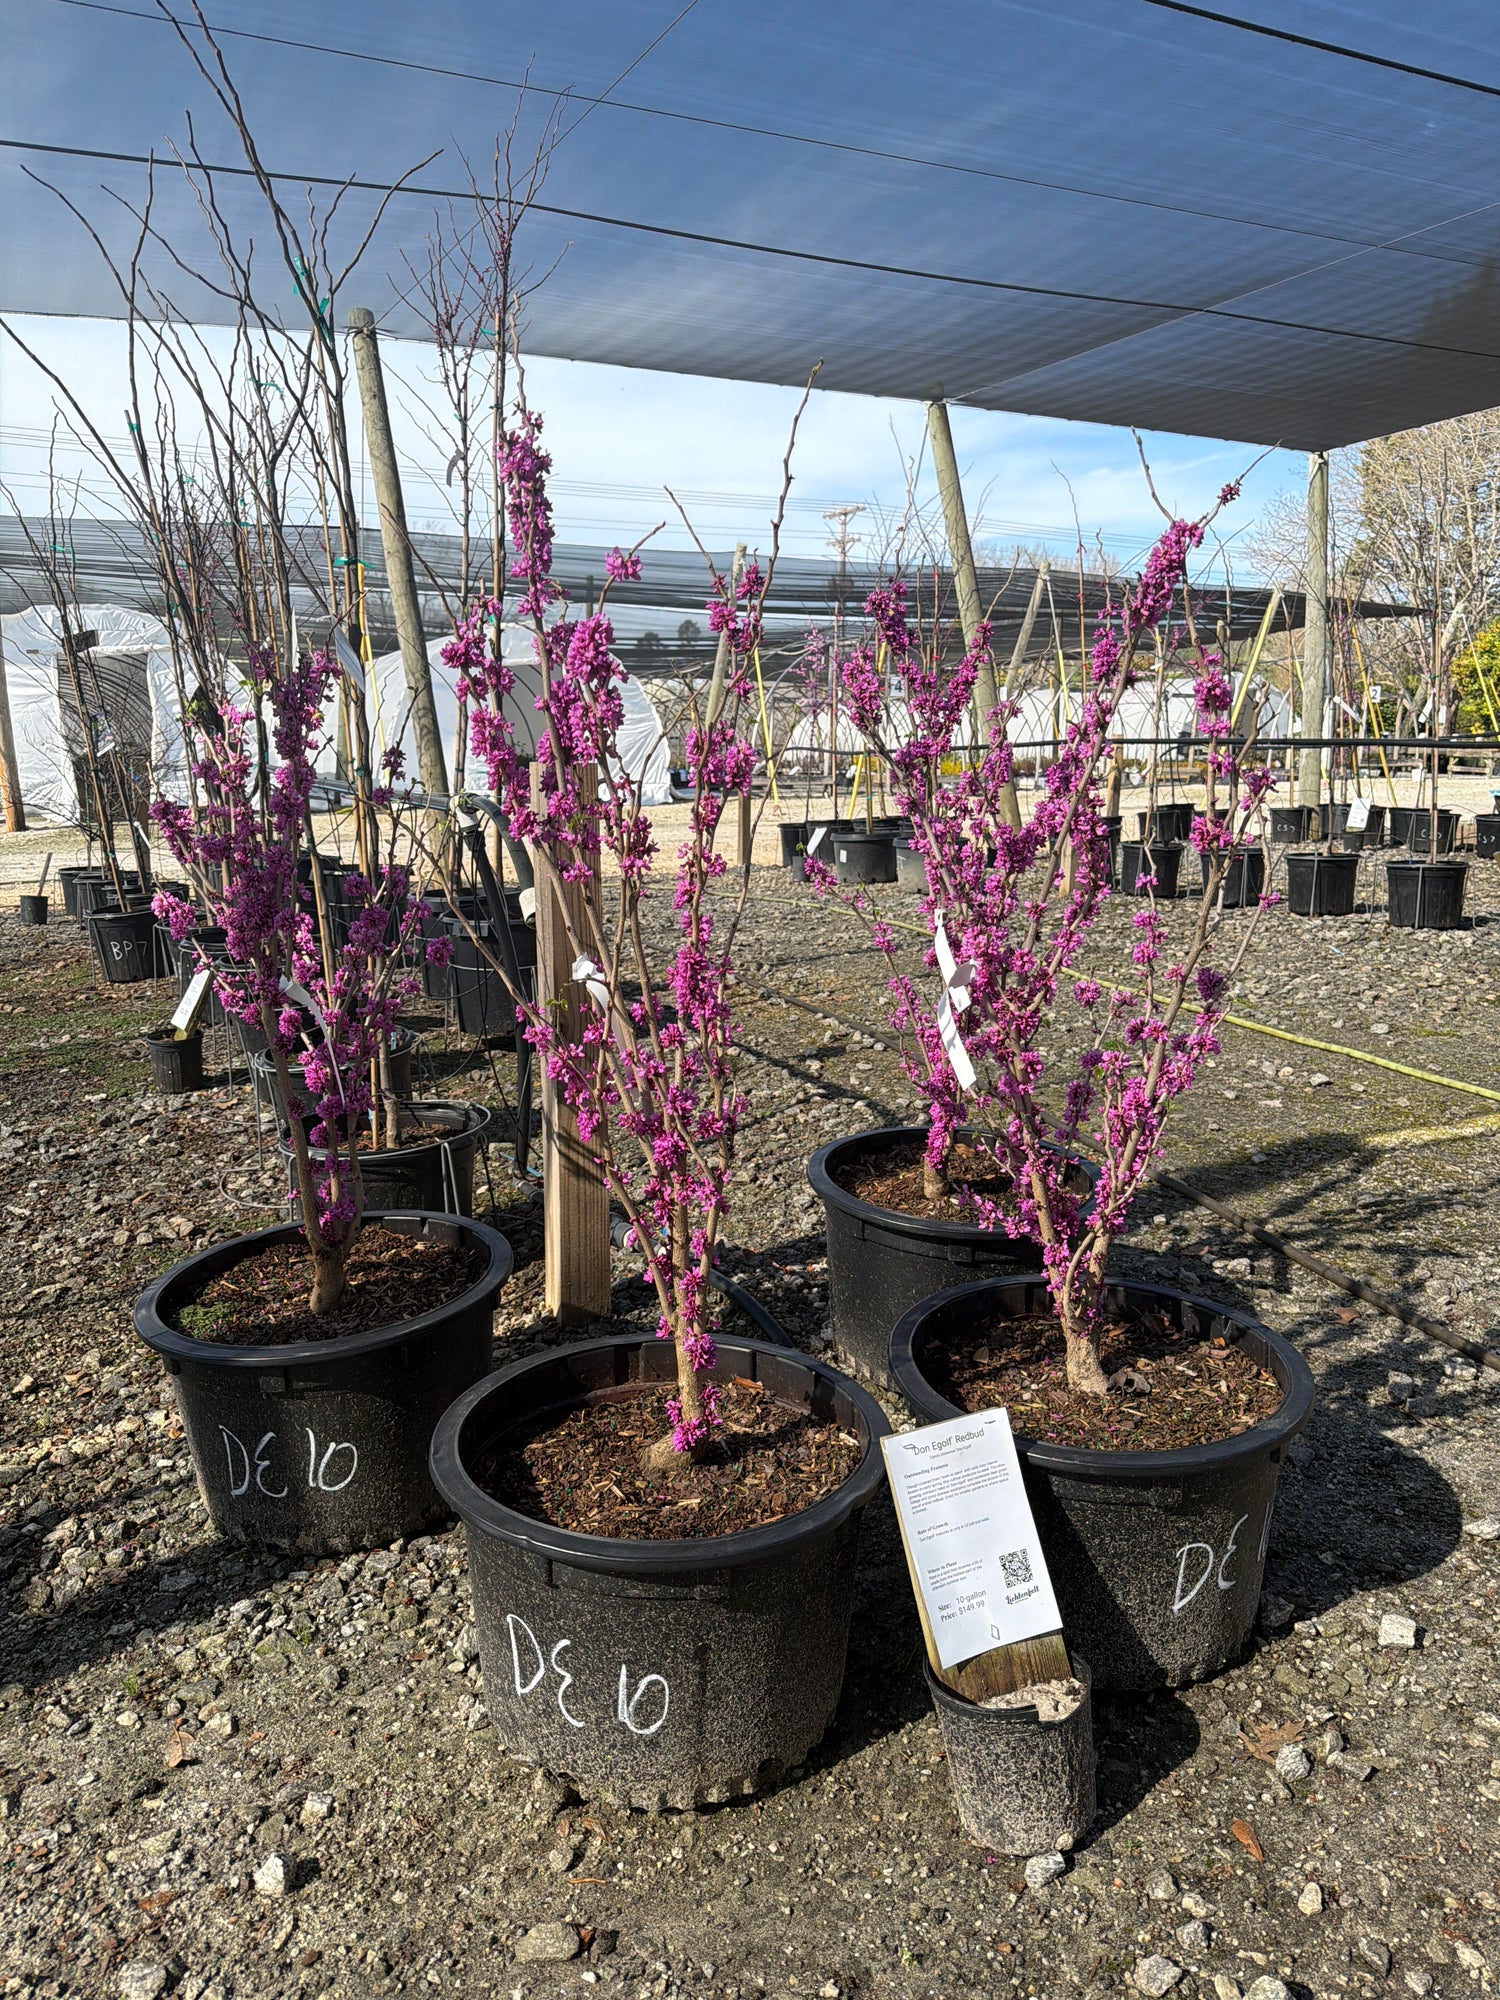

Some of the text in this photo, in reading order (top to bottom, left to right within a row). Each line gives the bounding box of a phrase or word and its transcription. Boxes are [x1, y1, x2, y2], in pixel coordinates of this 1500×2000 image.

[894, 679, 902, 693] 4
[1371, 689, 1378, 700] 2
[955, 1428, 985, 1444] Redbud
[219, 1424, 357, 1500] DE 10
[938, 1590, 987, 1612] Size: 10-gallon
[941, 1600, 985, 1623] Price: $149.99
[507, 1614, 669, 1734] DE 10
